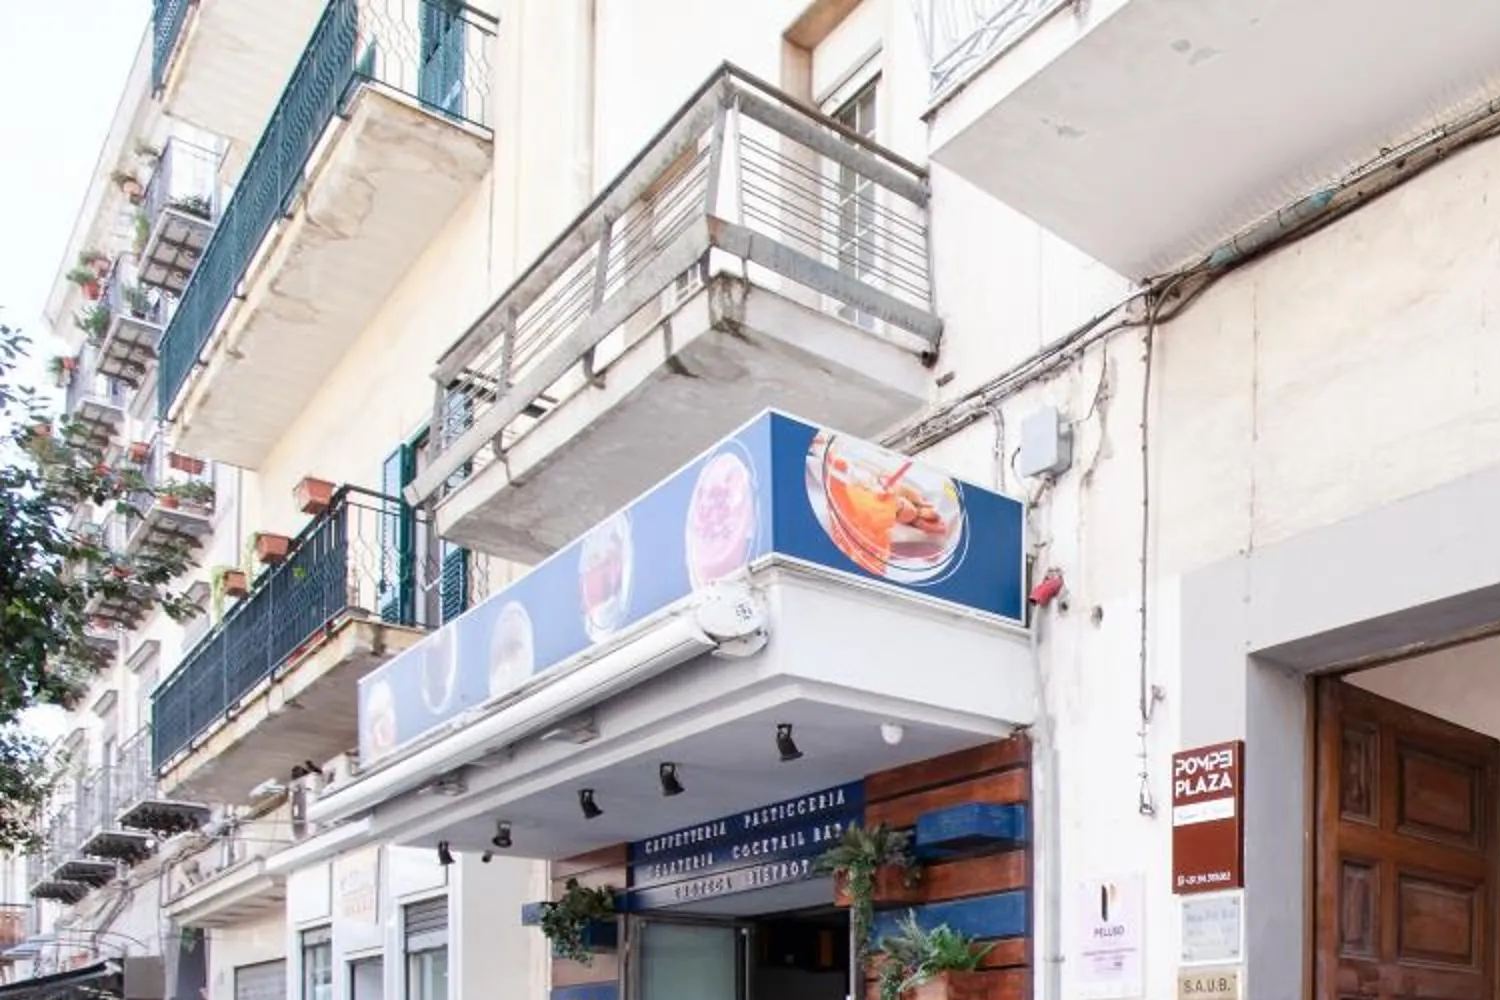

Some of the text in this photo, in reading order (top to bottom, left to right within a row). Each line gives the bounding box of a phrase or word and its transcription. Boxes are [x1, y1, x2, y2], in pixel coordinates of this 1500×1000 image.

[1175, 772, 1233, 798] PLAZA
[645, 789, 845, 854] CAFFETTERIA PASTICCERIA
[732, 831, 805, 859] COCKTAIL
[1183, 977, 1231, 995] S.A.U.B.
